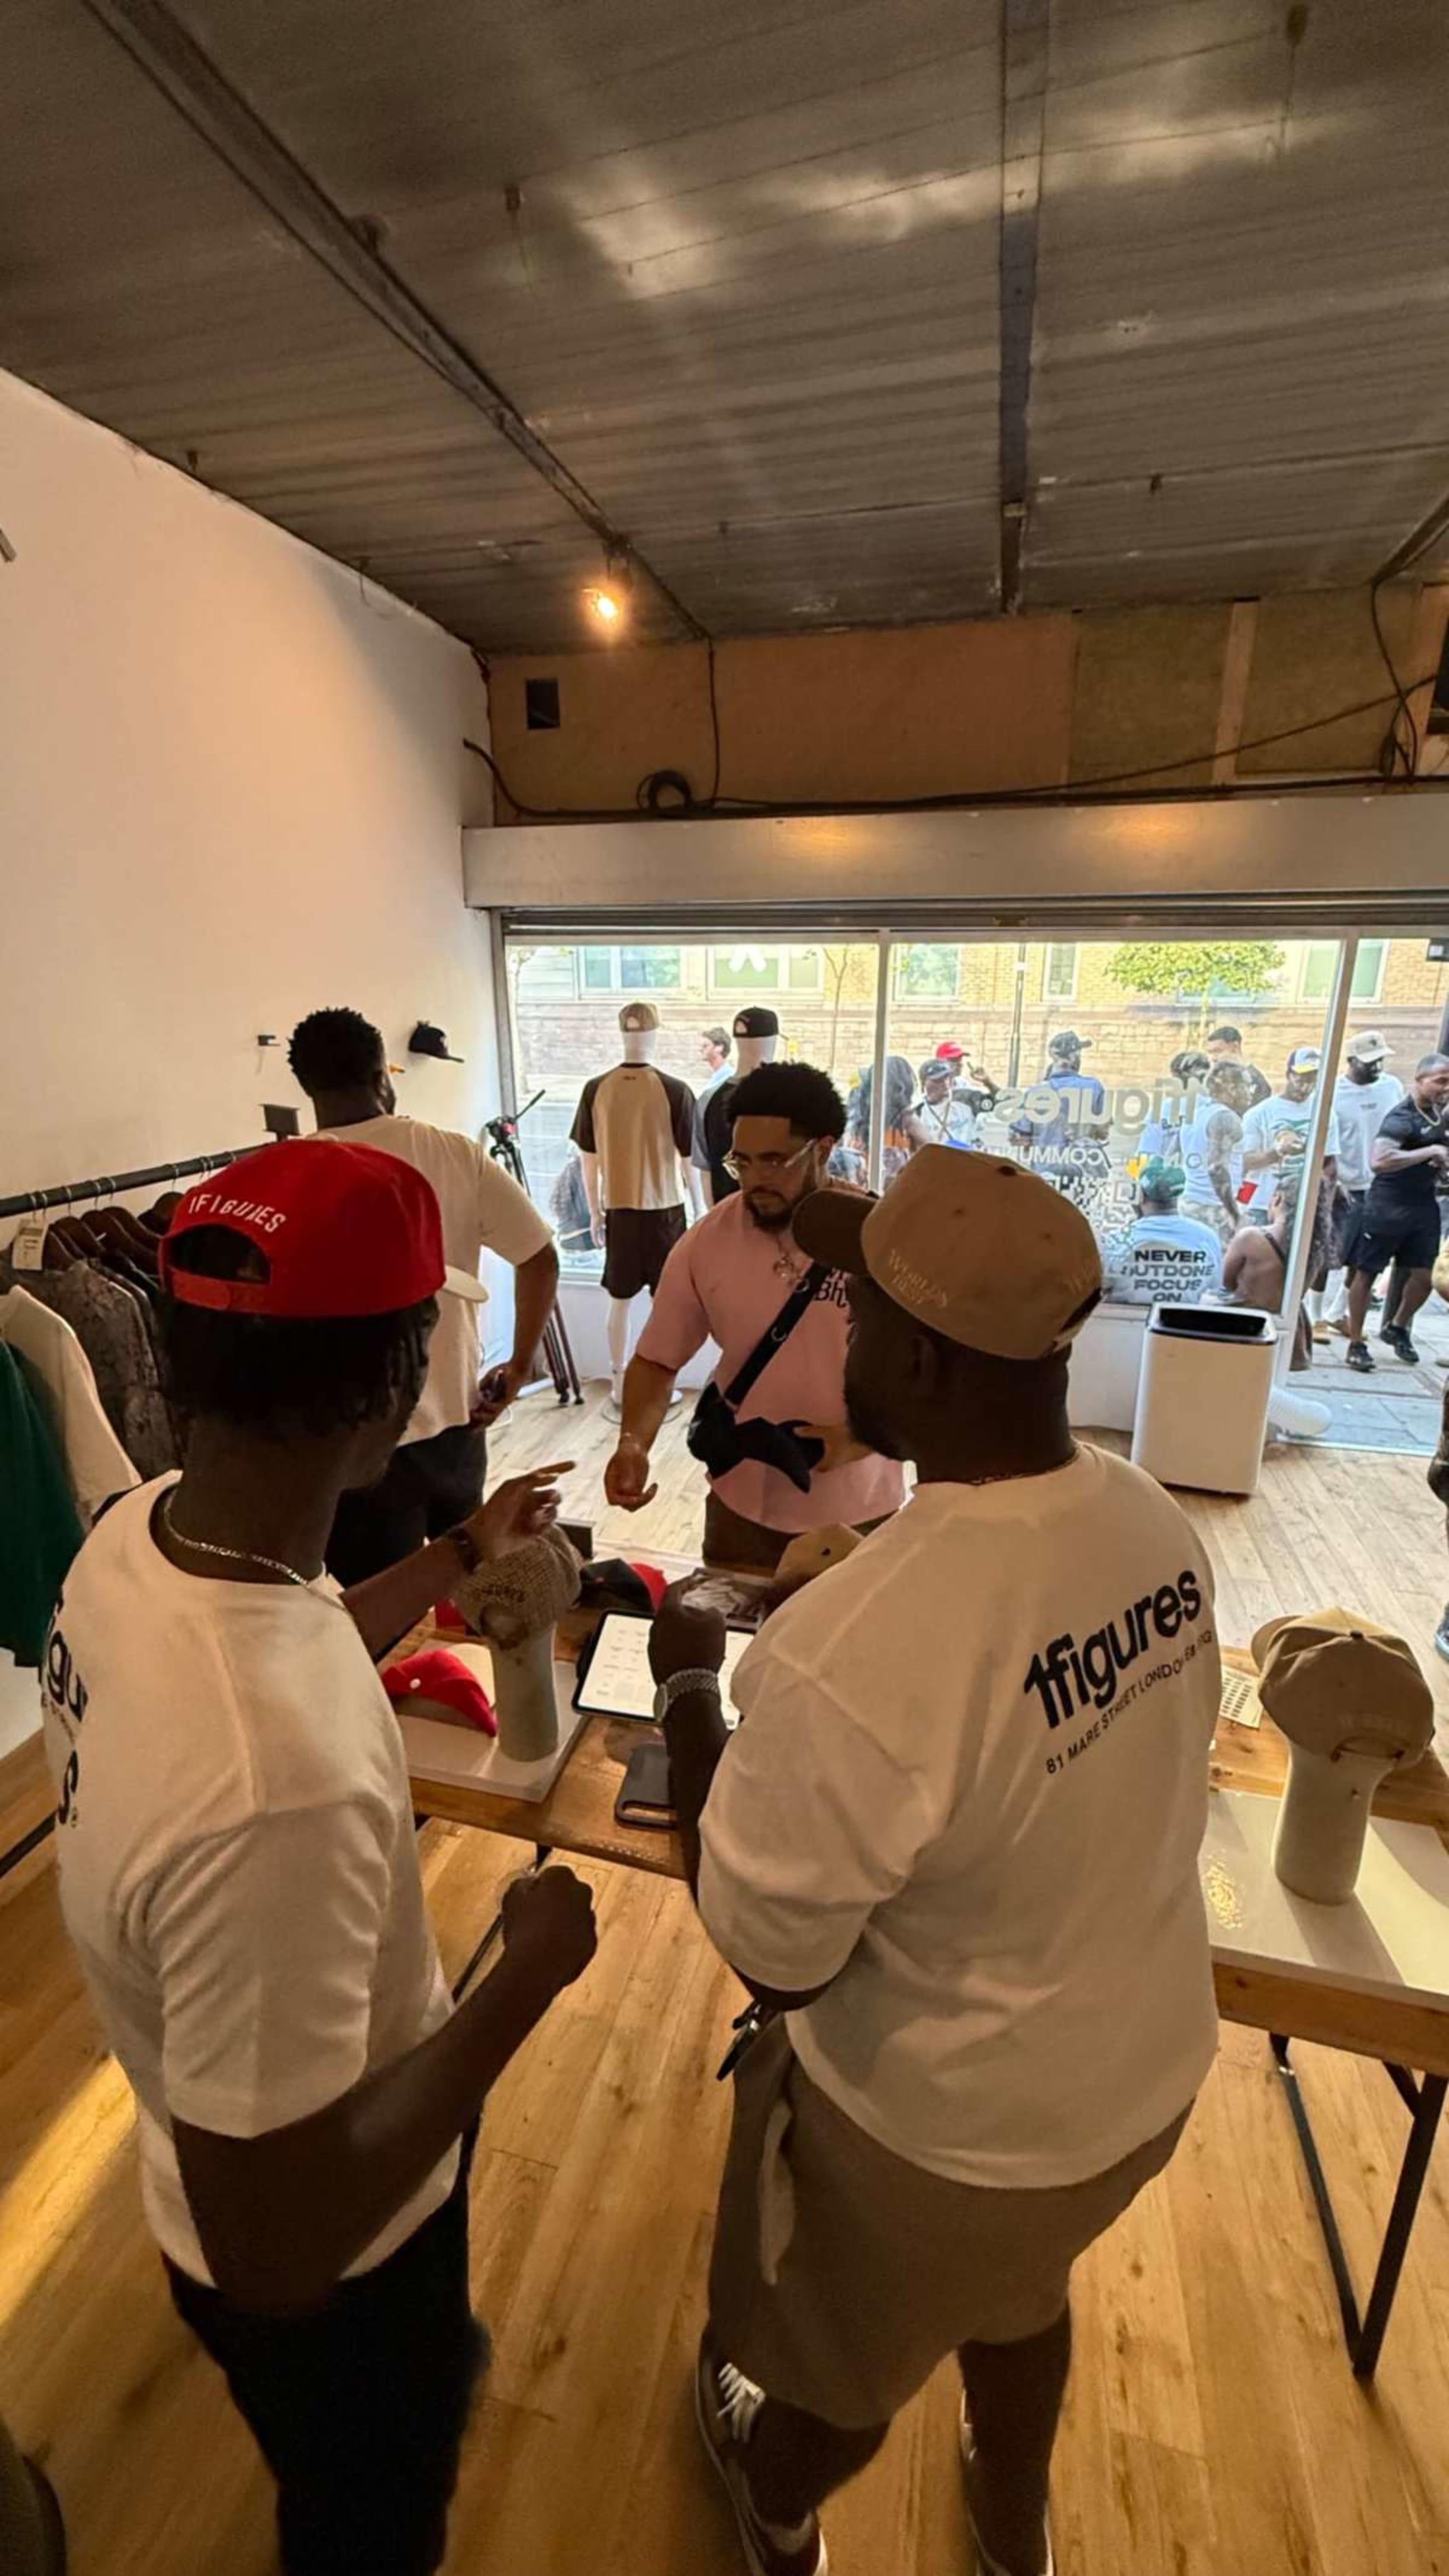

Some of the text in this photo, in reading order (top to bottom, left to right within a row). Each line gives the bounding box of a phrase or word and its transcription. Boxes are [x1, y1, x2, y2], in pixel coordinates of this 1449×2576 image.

[1134, 1250, 1206, 1262] NEVER
[1134, 1279, 1202, 1291] FOCUS
[1153, 1292, 1182, 1302] ON
[1023, 1570, 1201, 1729] 1figures
[1046, 1754, 1064, 1774] 81
[1068, 1721, 1101, 1761] MARE
[1138, 1659, 1184, 1693] LONDO
